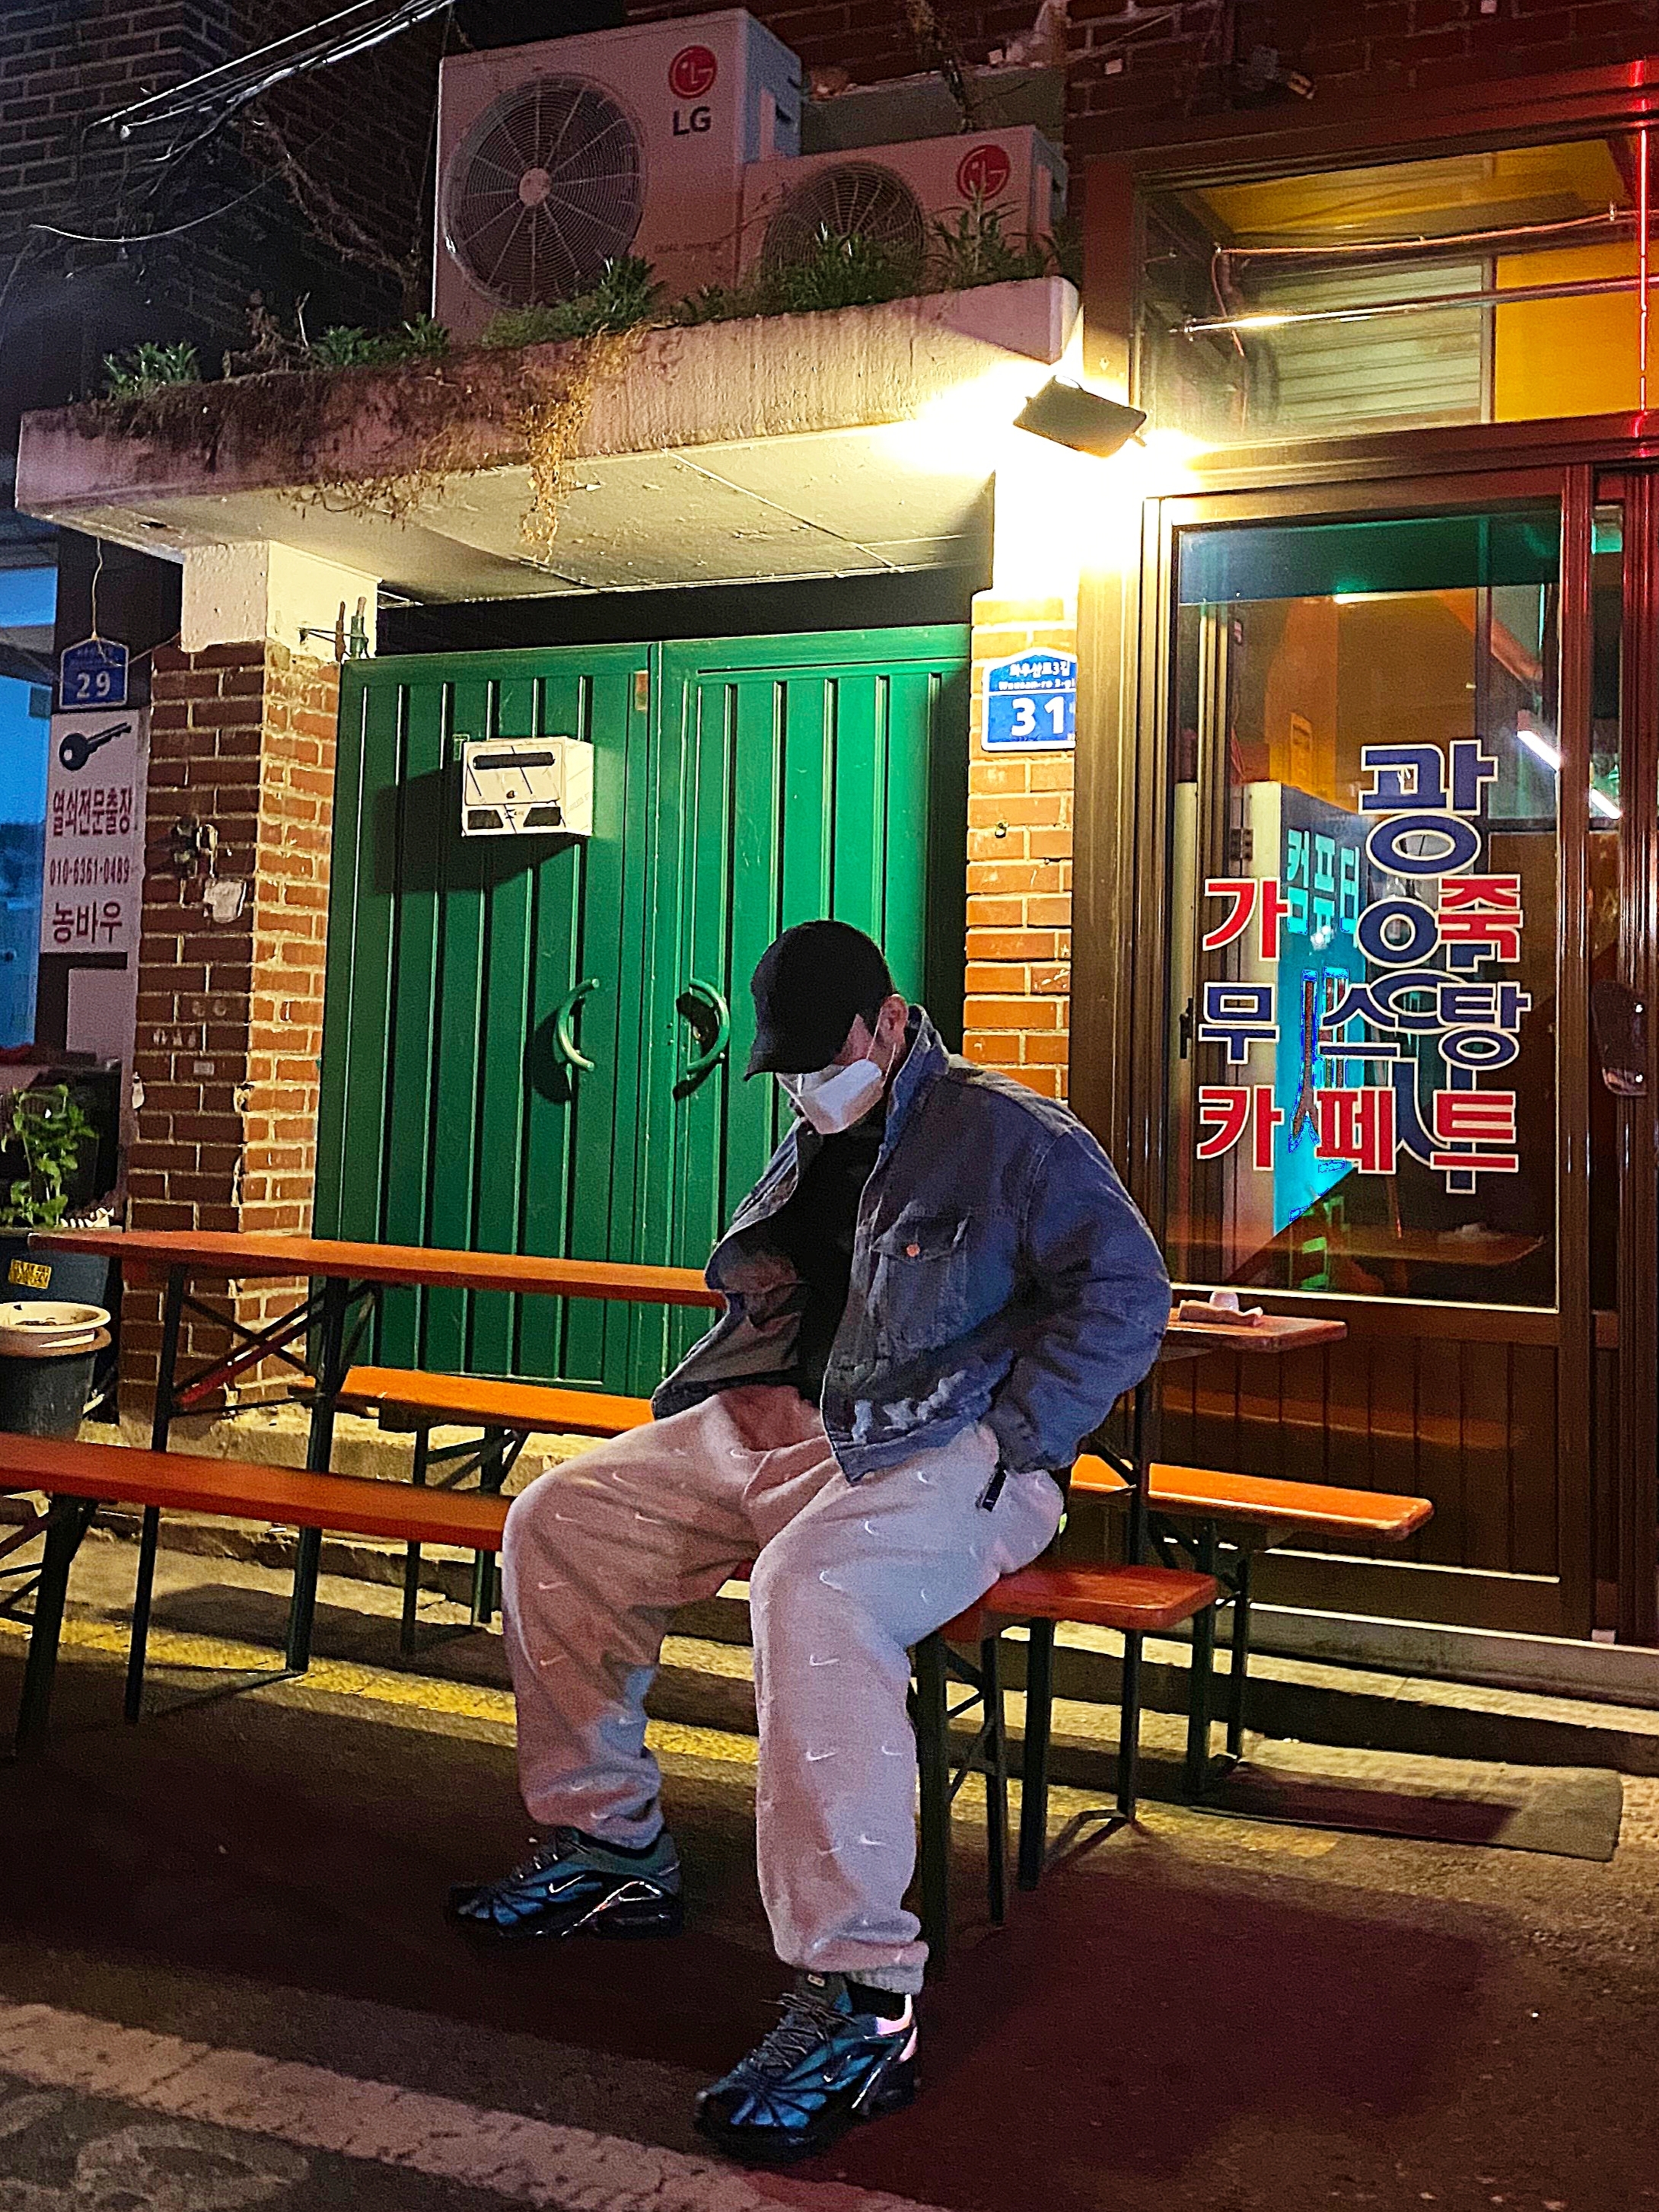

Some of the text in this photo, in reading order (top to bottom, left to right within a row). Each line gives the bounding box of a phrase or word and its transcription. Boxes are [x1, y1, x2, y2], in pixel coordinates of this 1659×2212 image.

[673, 107, 712, 135] LG
[76, 671, 110, 698] 29
[1011, 696, 1065, 737] 31
[1202, 874, 1524, 964] 가죽
[1286, 828, 1361, 949] 컴퓨터
[53, 901, 123, 944] 농바우
[1197, 980, 1532, 1072] 무스탕
[1196, 1085, 1520, 1175] 카페트
